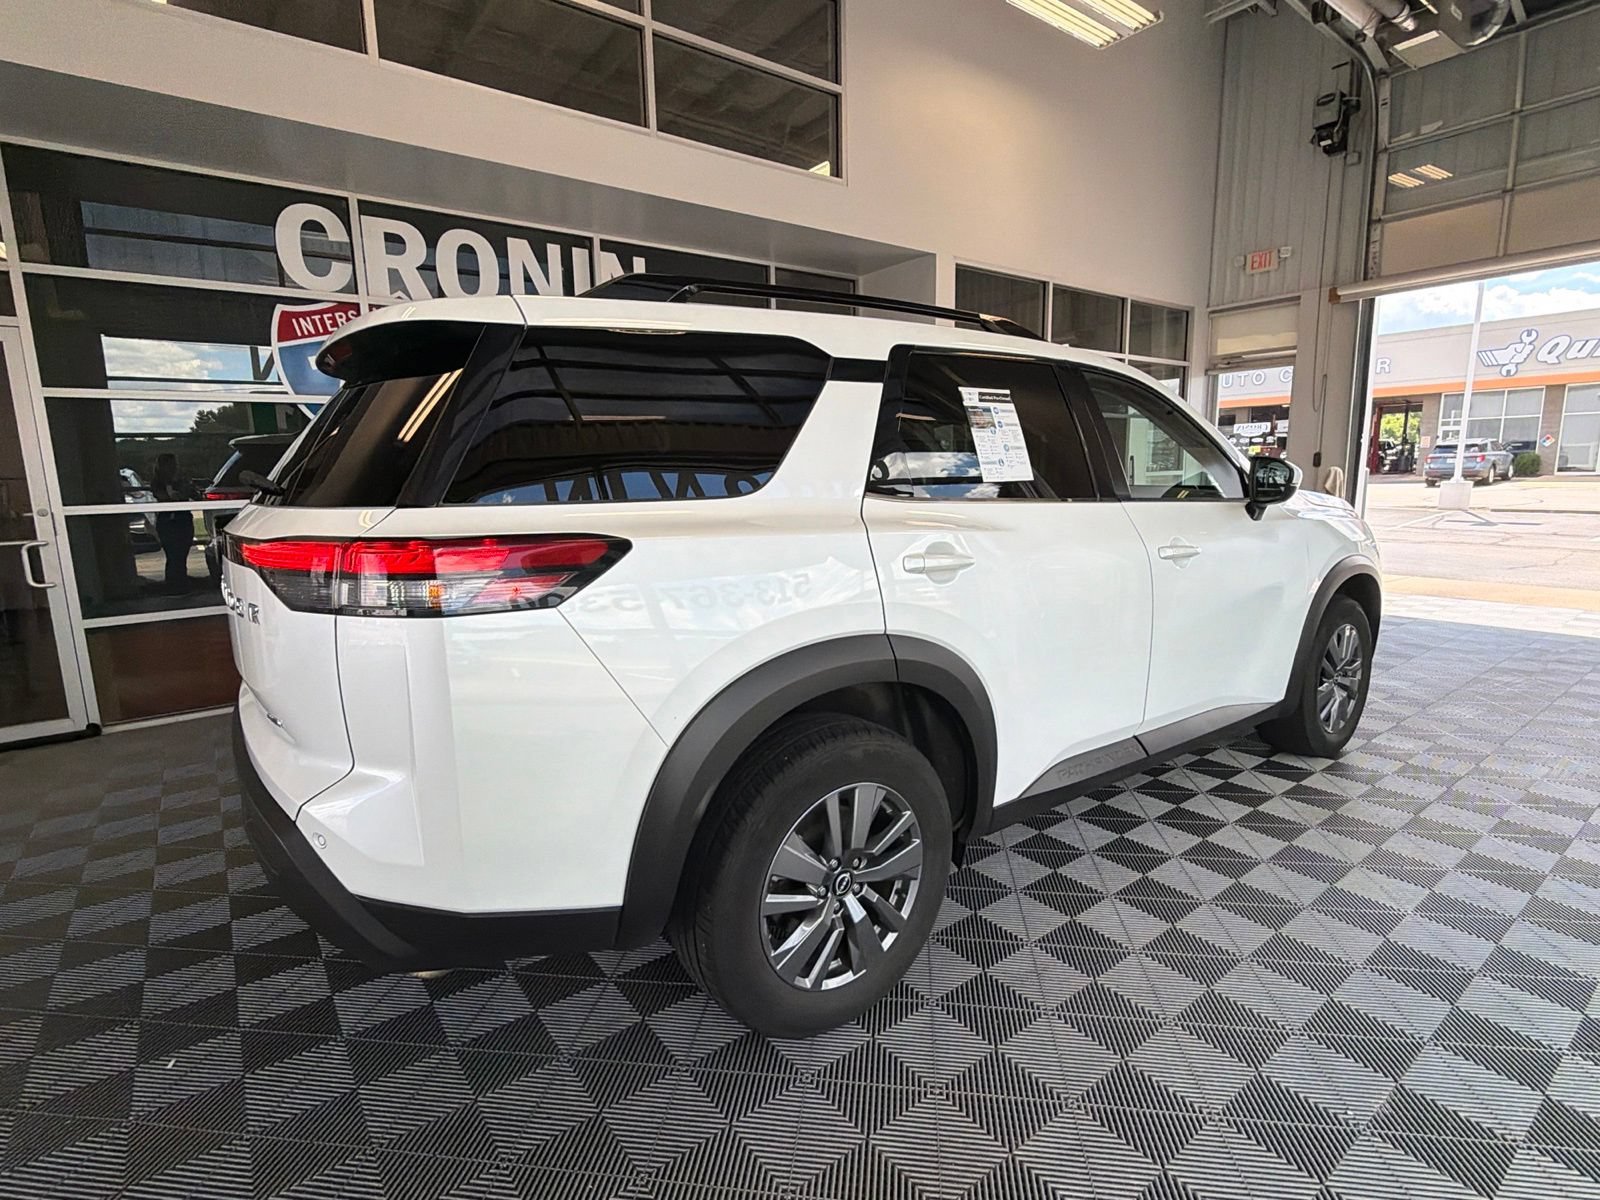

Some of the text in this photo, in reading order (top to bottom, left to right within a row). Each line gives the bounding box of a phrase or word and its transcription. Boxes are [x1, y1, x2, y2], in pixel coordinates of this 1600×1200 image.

[1250, 250, 1273, 271] EXIT
[1536, 334, 1600, 365] Qu
[1221, 370, 1266, 388] UTO
